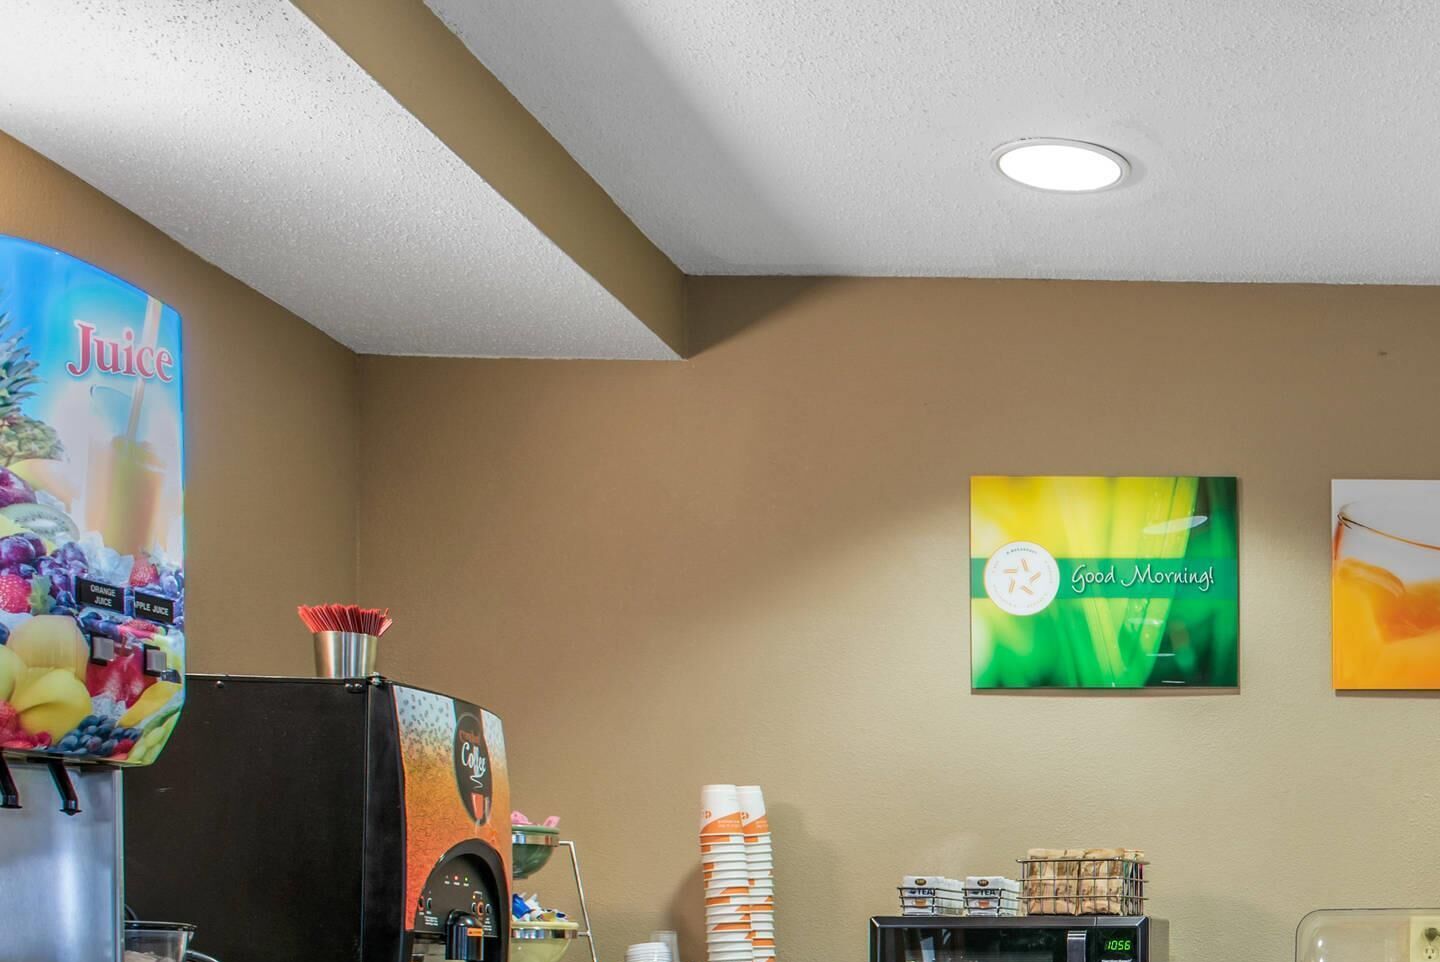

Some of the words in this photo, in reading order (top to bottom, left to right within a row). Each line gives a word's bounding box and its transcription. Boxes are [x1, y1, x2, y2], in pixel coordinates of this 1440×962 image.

[66, 321, 174, 382] Juice
[1071, 564, 1116, 593] Good
[1121, 563, 1215, 592] Morning!
[90, 584, 116, 597] ORANGE
[94, 596, 113, 607] JUICE
[152, 604, 169, 616] JUICE
